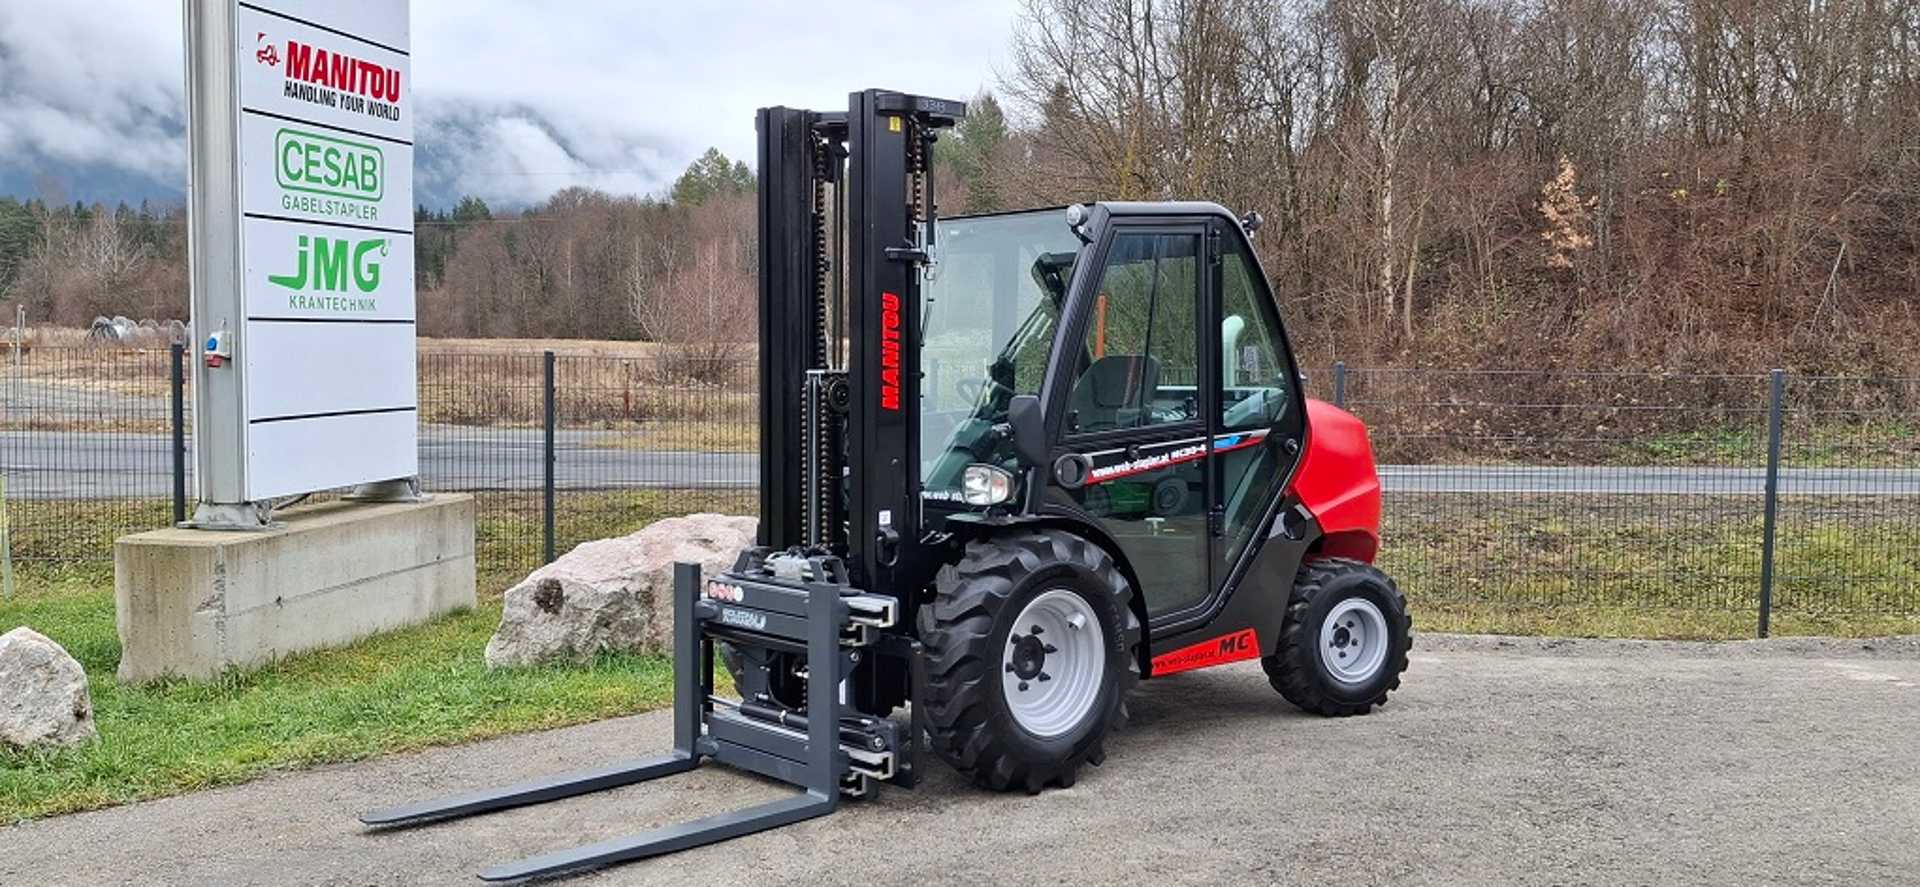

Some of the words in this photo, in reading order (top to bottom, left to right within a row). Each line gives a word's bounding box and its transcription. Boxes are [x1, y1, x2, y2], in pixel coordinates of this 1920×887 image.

[285, 41, 400, 103] MANITOU
[284, 81, 336, 107] HANDLING
[339, 94, 364, 113] YOUR
[366, 100, 400, 121] WORLD
[283, 140, 378, 192] CESAB
[281, 194, 378, 220] GABELSTAPLER
[289, 295, 377, 311] KRANTECHNIK
[882, 291, 900, 410] MANITOU
[1219, 631, 1251, 657] MC
